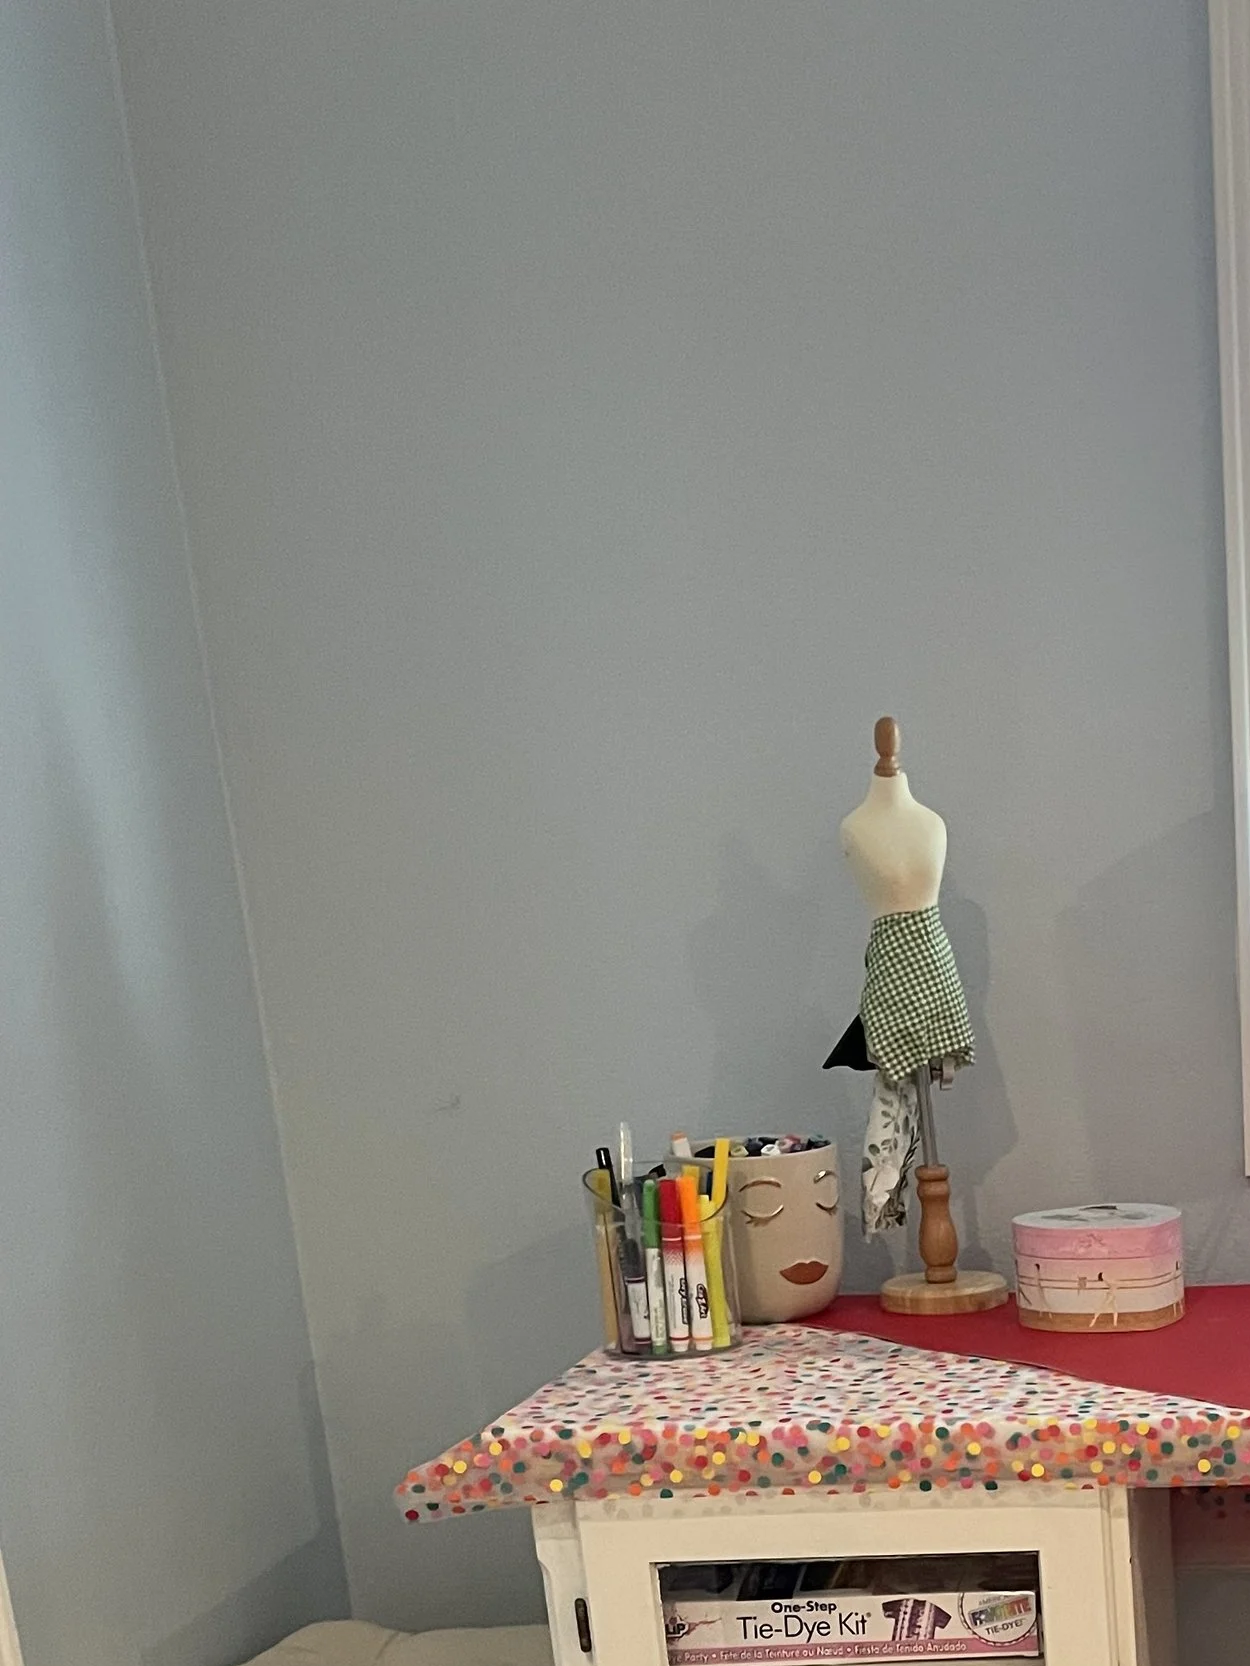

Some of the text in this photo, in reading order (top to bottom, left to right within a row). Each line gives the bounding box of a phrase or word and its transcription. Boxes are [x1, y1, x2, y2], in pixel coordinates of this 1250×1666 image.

[771, 1601, 837, 1615] One-Step
[736, 1614, 831, 1643] Tie-Dye
[740, 1649, 751, 1659] de
[882, 1643, 894, 1653] de
